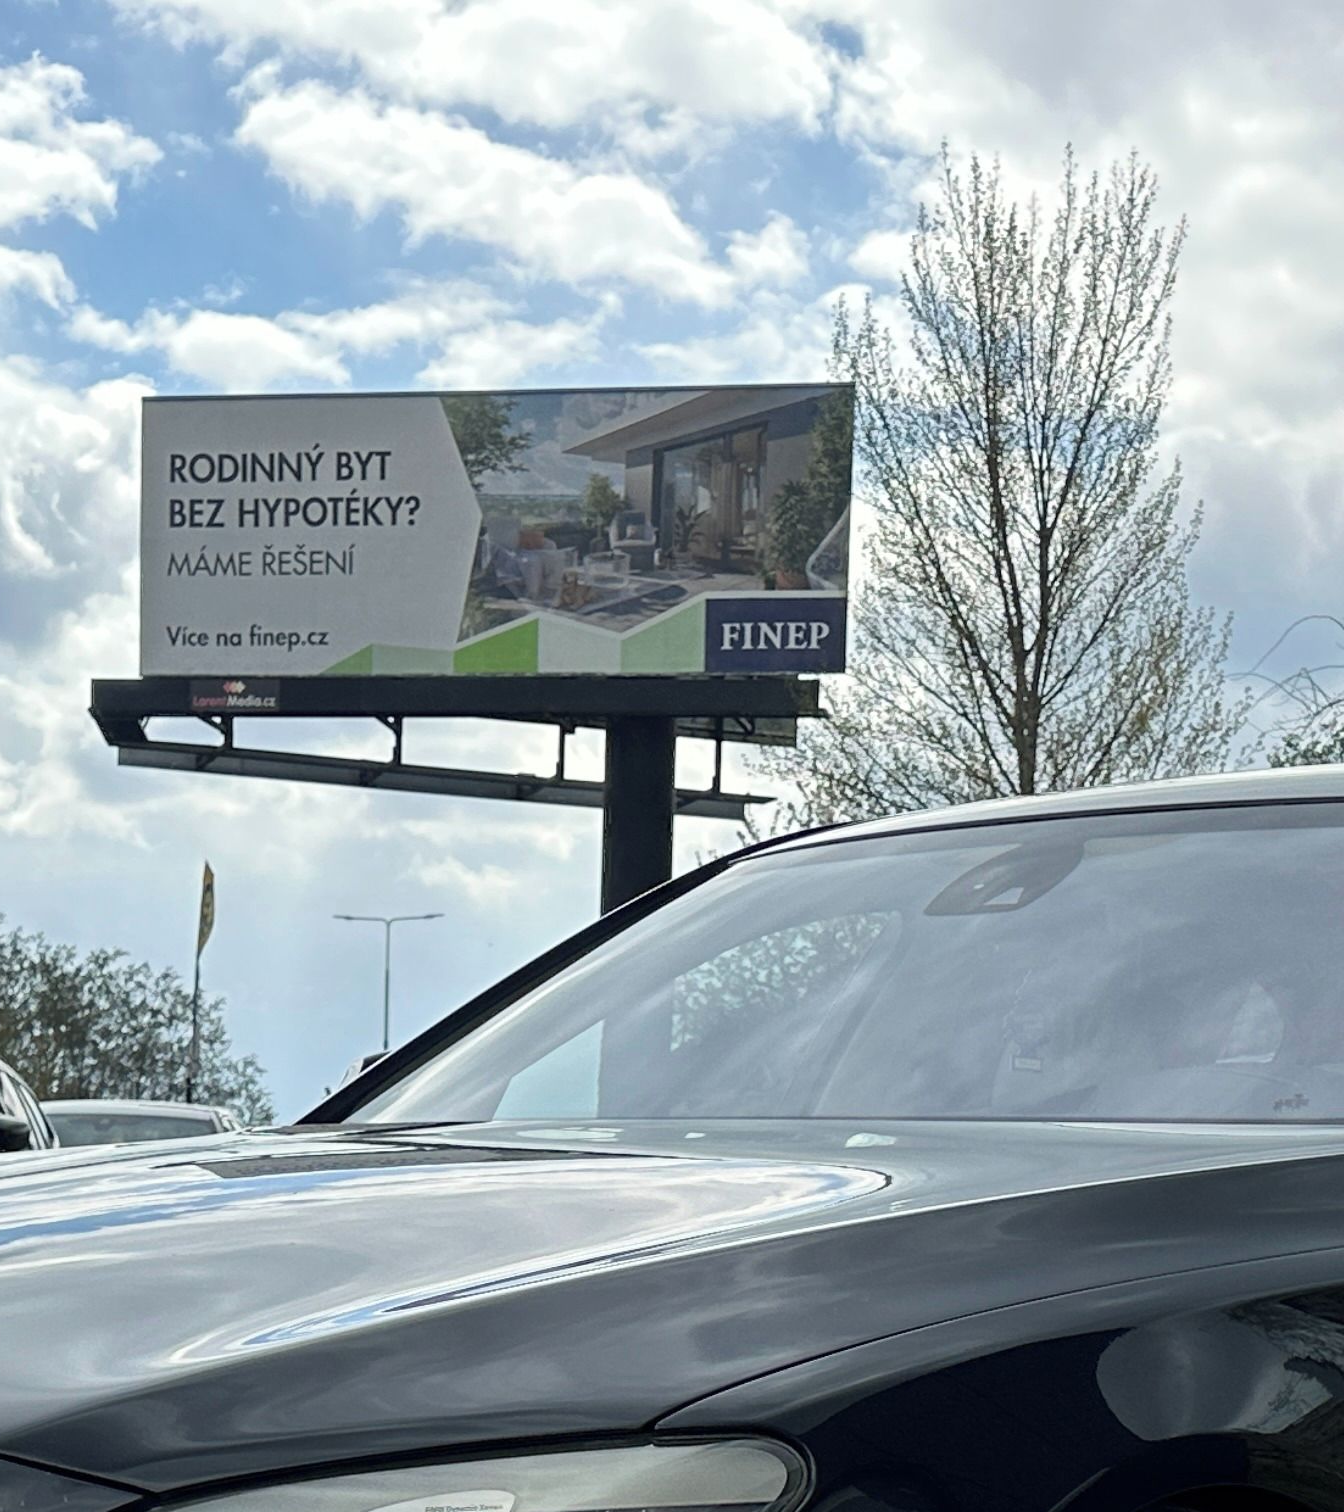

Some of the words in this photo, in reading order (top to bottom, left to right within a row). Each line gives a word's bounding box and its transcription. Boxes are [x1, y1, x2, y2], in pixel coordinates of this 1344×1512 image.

[169, 443, 325, 483] RODINNÝ
[336, 451, 392, 481] BYT
[169, 498, 225, 528] BEZ
[238, 488, 421, 528] HYPOTÉKY?
[167, 545, 253, 576] MÁME
[262, 544, 355, 576] ŘEŠENÍ
[166, 625, 210, 647] Více
[216, 632, 242, 647] na
[249, 624, 330, 652] finep.cz
[720, 621, 831, 650] FINEP
